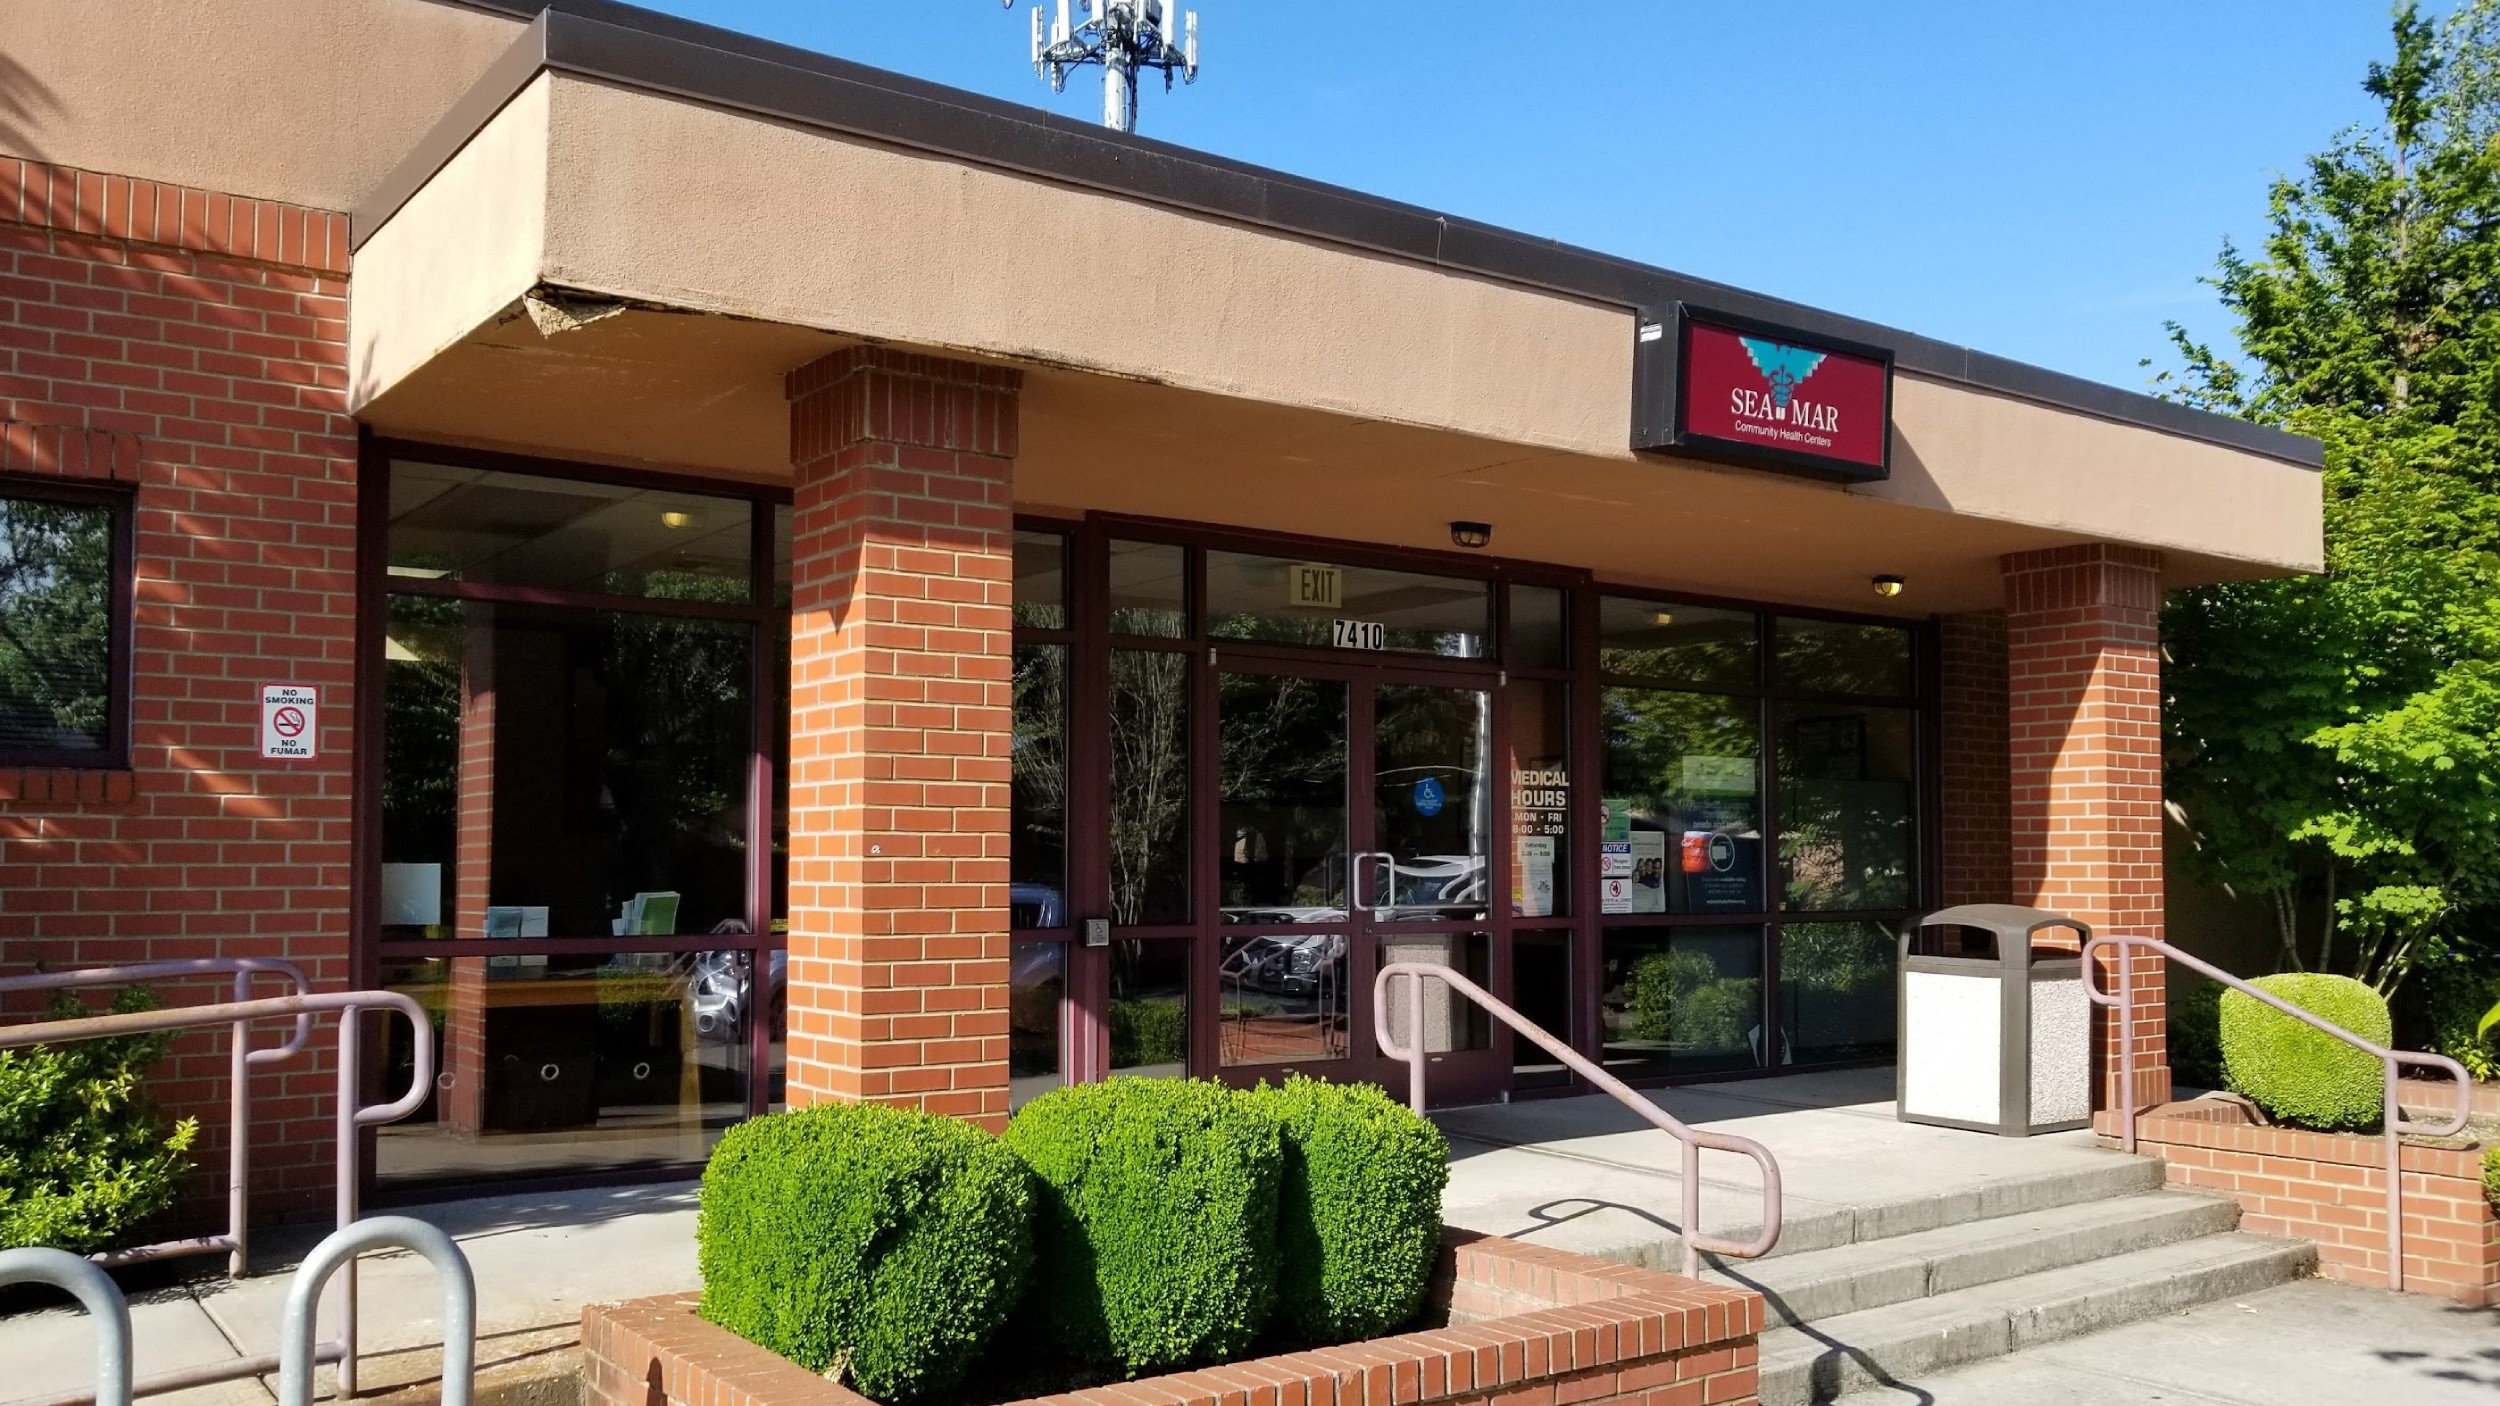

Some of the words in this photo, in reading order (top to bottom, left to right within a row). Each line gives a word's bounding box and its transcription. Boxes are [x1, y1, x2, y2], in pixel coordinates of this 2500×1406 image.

[1731, 387, 1774, 420] SEA
[1791, 399, 1839, 432] MAR
[1735, 419, 1779, 440] Community
[1779, 428, 1804, 442] Health
[1804, 432, 1832, 447] Centers
[1301, 569, 1334, 603] EXIT
[1335, 620, 1382, 649] 7410
[265, 696, 314, 705] SMOKING
[281, 739, 297, 747] NO
[270, 747, 307, 755] FUMAR
[1511, 770, 1570, 787] MEDICAL
[1511, 789, 1566, 806] HOURS
[1514, 812, 1537, 822] MON
[1547, 813, 1562, 822] FRI
[1512, 824, 1533, 834] 8:00
[1544, 825, 1564, 834] 5:00
[1602, 844, 1628, 853] NOTICE
